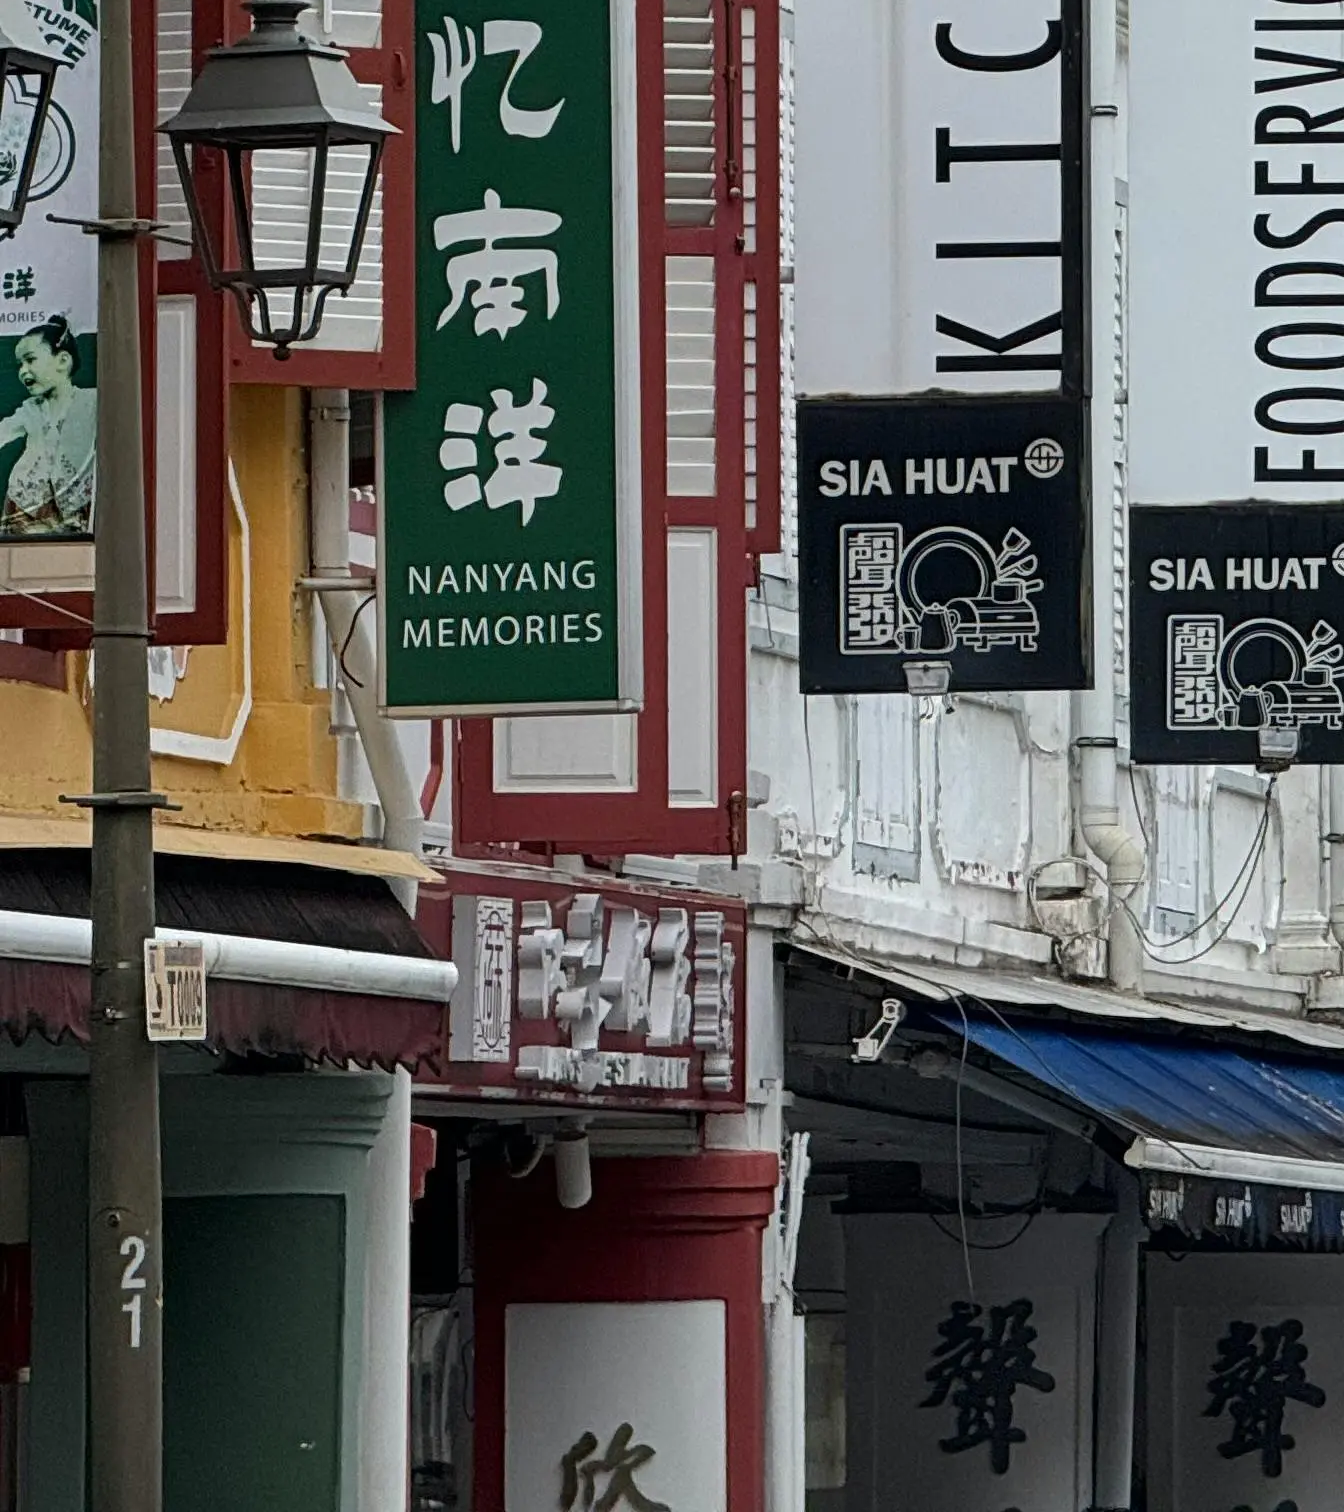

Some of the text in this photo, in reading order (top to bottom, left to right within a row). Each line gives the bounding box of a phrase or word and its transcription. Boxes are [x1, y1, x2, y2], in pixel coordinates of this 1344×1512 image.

[426, 15, 565, 526] 忆南洋
[819, 456, 1018, 498] SIA HUAT
[408, 558, 598, 595] NANYANG
[1149, 557, 1327, 592] SIA HUAT
[402, 612, 602, 649] MEMORIES
